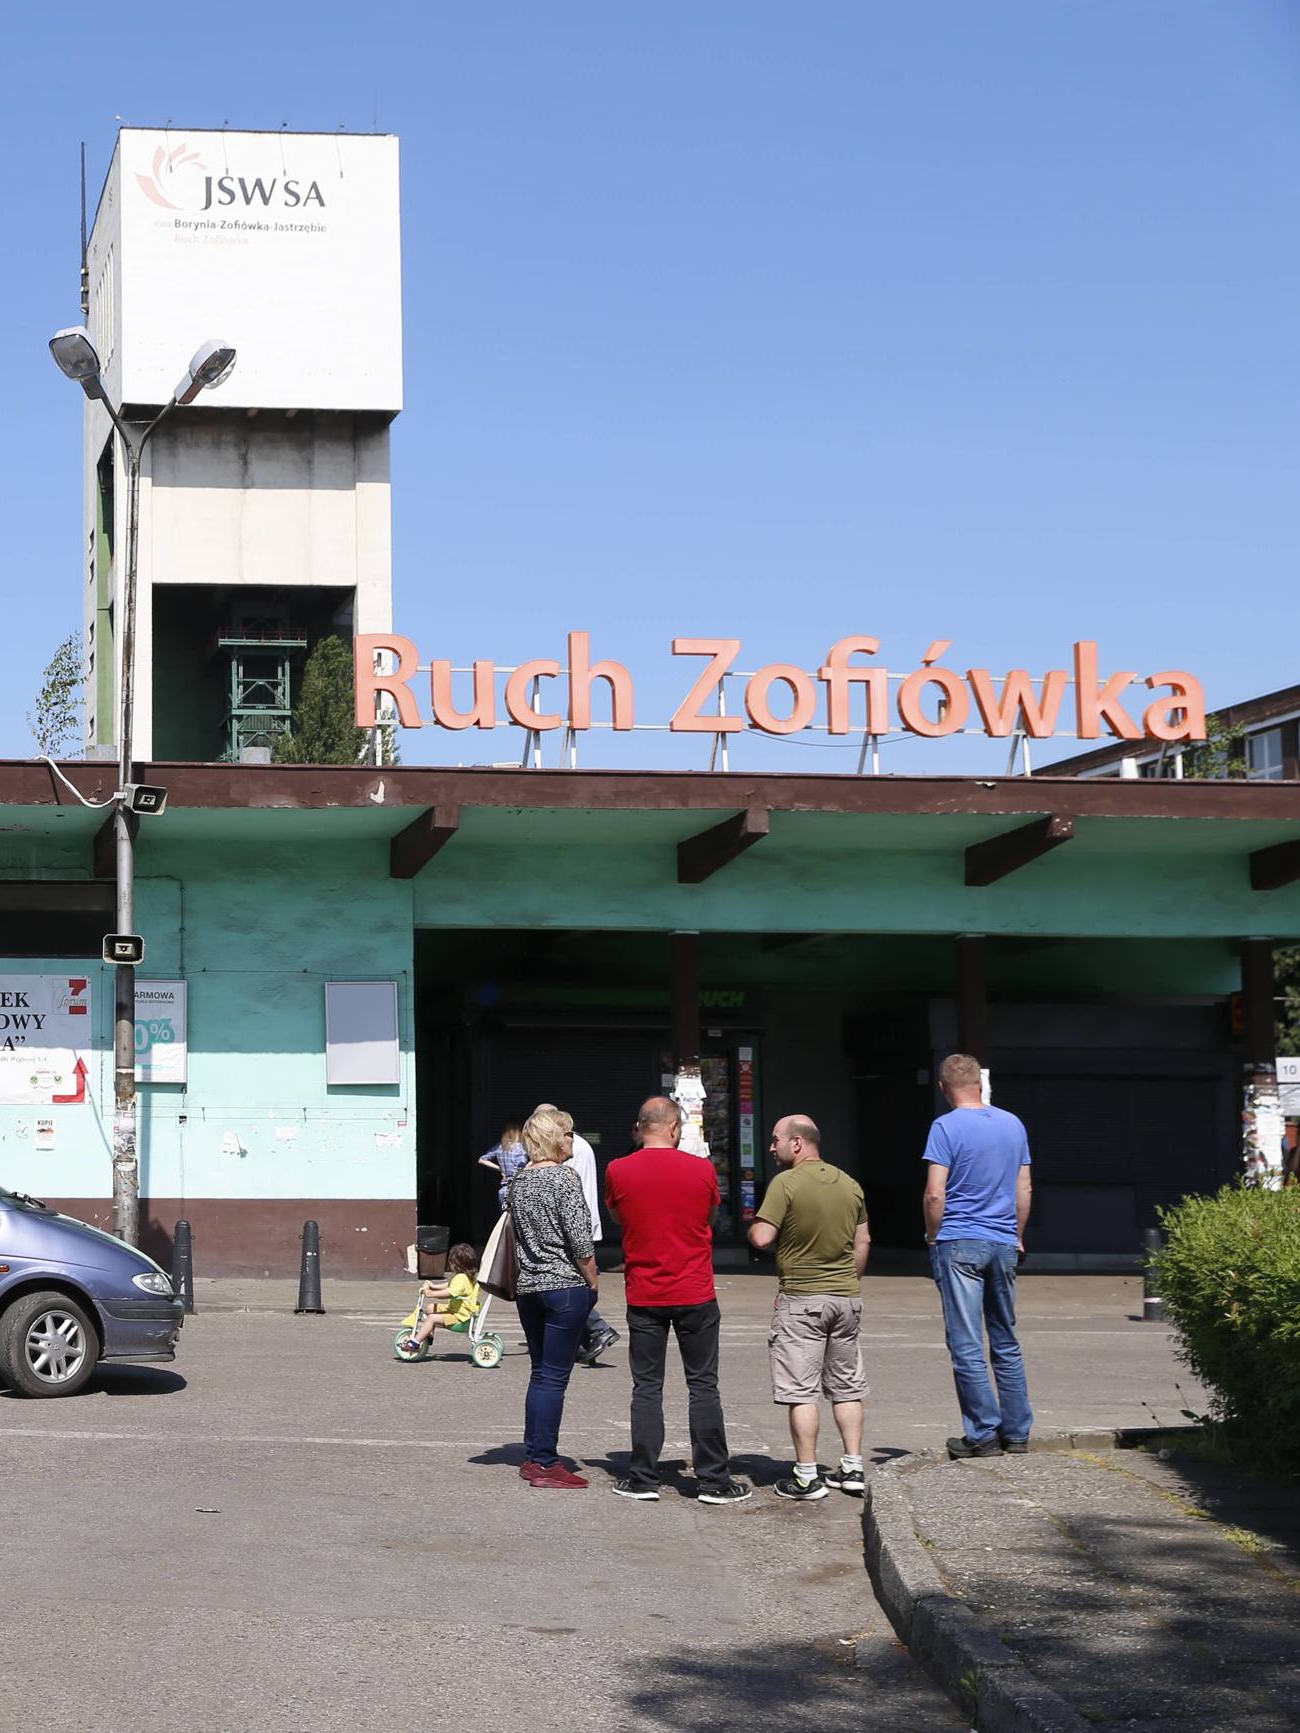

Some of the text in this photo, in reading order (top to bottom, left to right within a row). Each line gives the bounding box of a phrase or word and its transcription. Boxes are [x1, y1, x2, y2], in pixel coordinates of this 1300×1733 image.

[200, 176, 326, 211] JSW SA
[354, 631, 1209, 743] Ruch Zofiówka
[134, 991, 175, 1000] ARMOWA
[698, 990, 746, 1008] UCH
